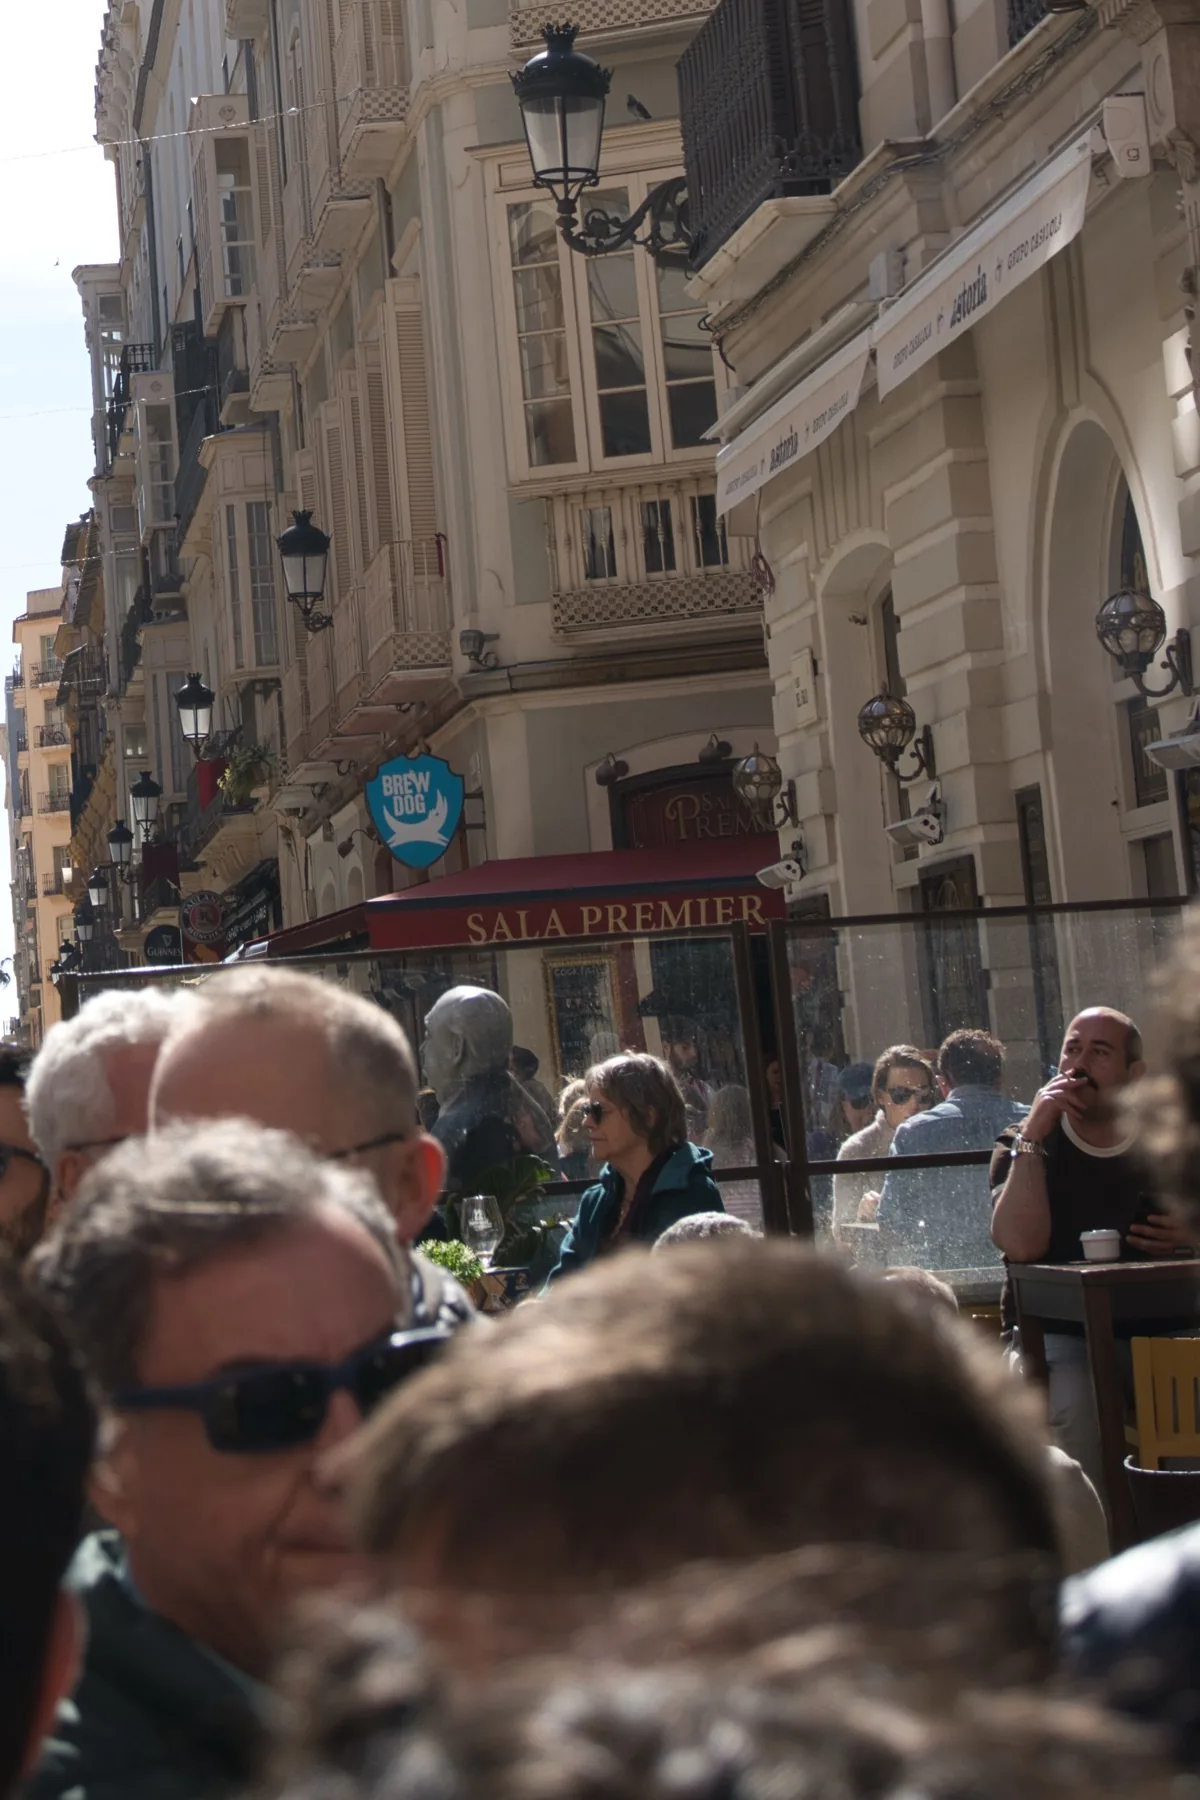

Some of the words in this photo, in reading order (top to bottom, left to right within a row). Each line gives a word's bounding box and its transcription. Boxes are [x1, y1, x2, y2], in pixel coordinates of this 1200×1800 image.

[950, 263, 988, 329] astoria
[382, 770, 430, 797] BREW
[393, 793, 426, 816] DOG
[466, 908, 569, 946] SALA
[579, 894, 767, 935] PREMIER
